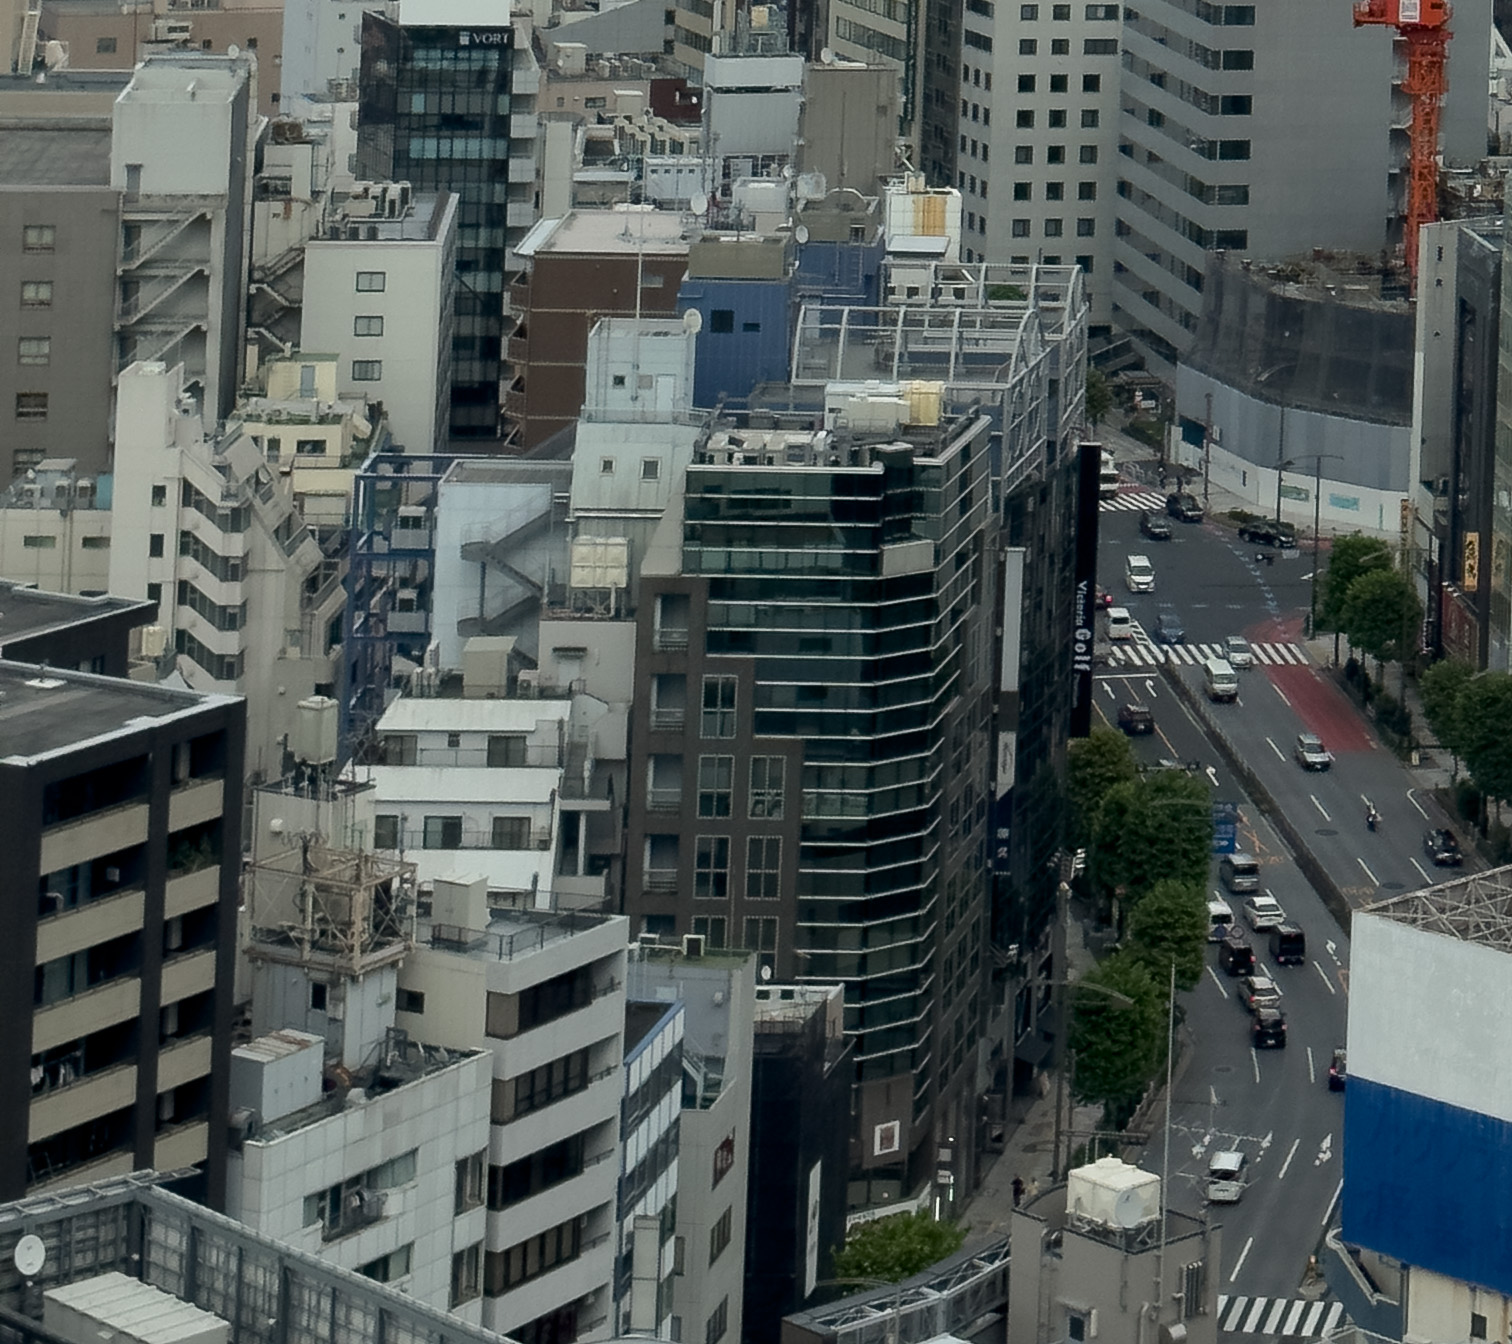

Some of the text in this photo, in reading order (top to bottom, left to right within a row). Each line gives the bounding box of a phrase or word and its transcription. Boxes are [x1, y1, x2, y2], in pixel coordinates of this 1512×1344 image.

[472, 32, 509, 45] VORT
[1075, 580, 1088, 627] Victoria
[1074, 627, 1092, 672] Golf
